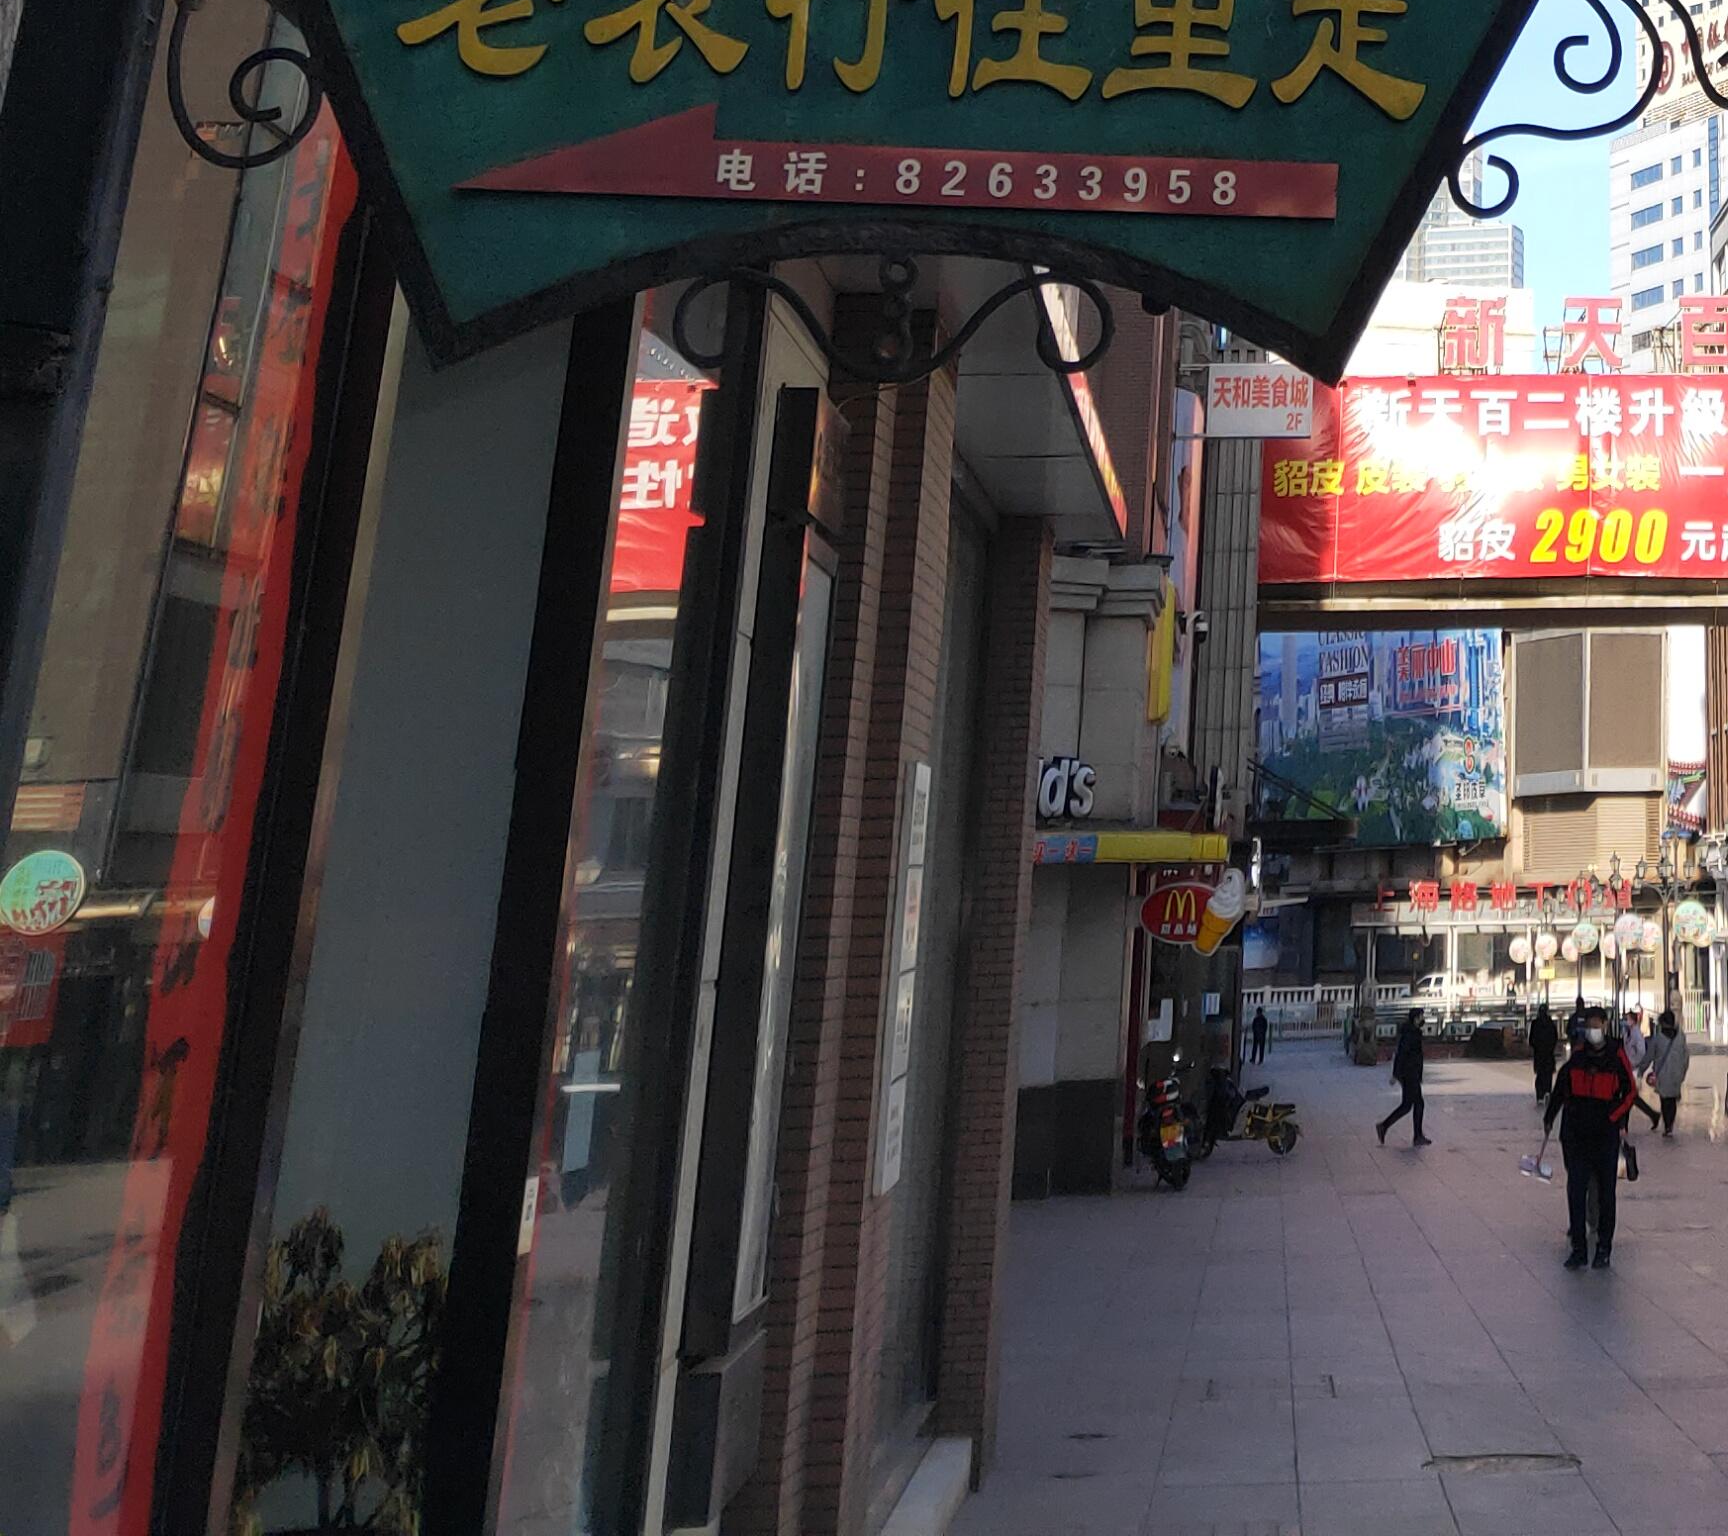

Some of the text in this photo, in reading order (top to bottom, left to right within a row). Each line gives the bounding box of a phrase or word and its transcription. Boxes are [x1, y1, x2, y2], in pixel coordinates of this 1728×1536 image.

[1212, 373, 1310, 410] 天和美食城
[1285, 412, 1304, 432] 2F
[1528, 507, 1669, 565] 2900
